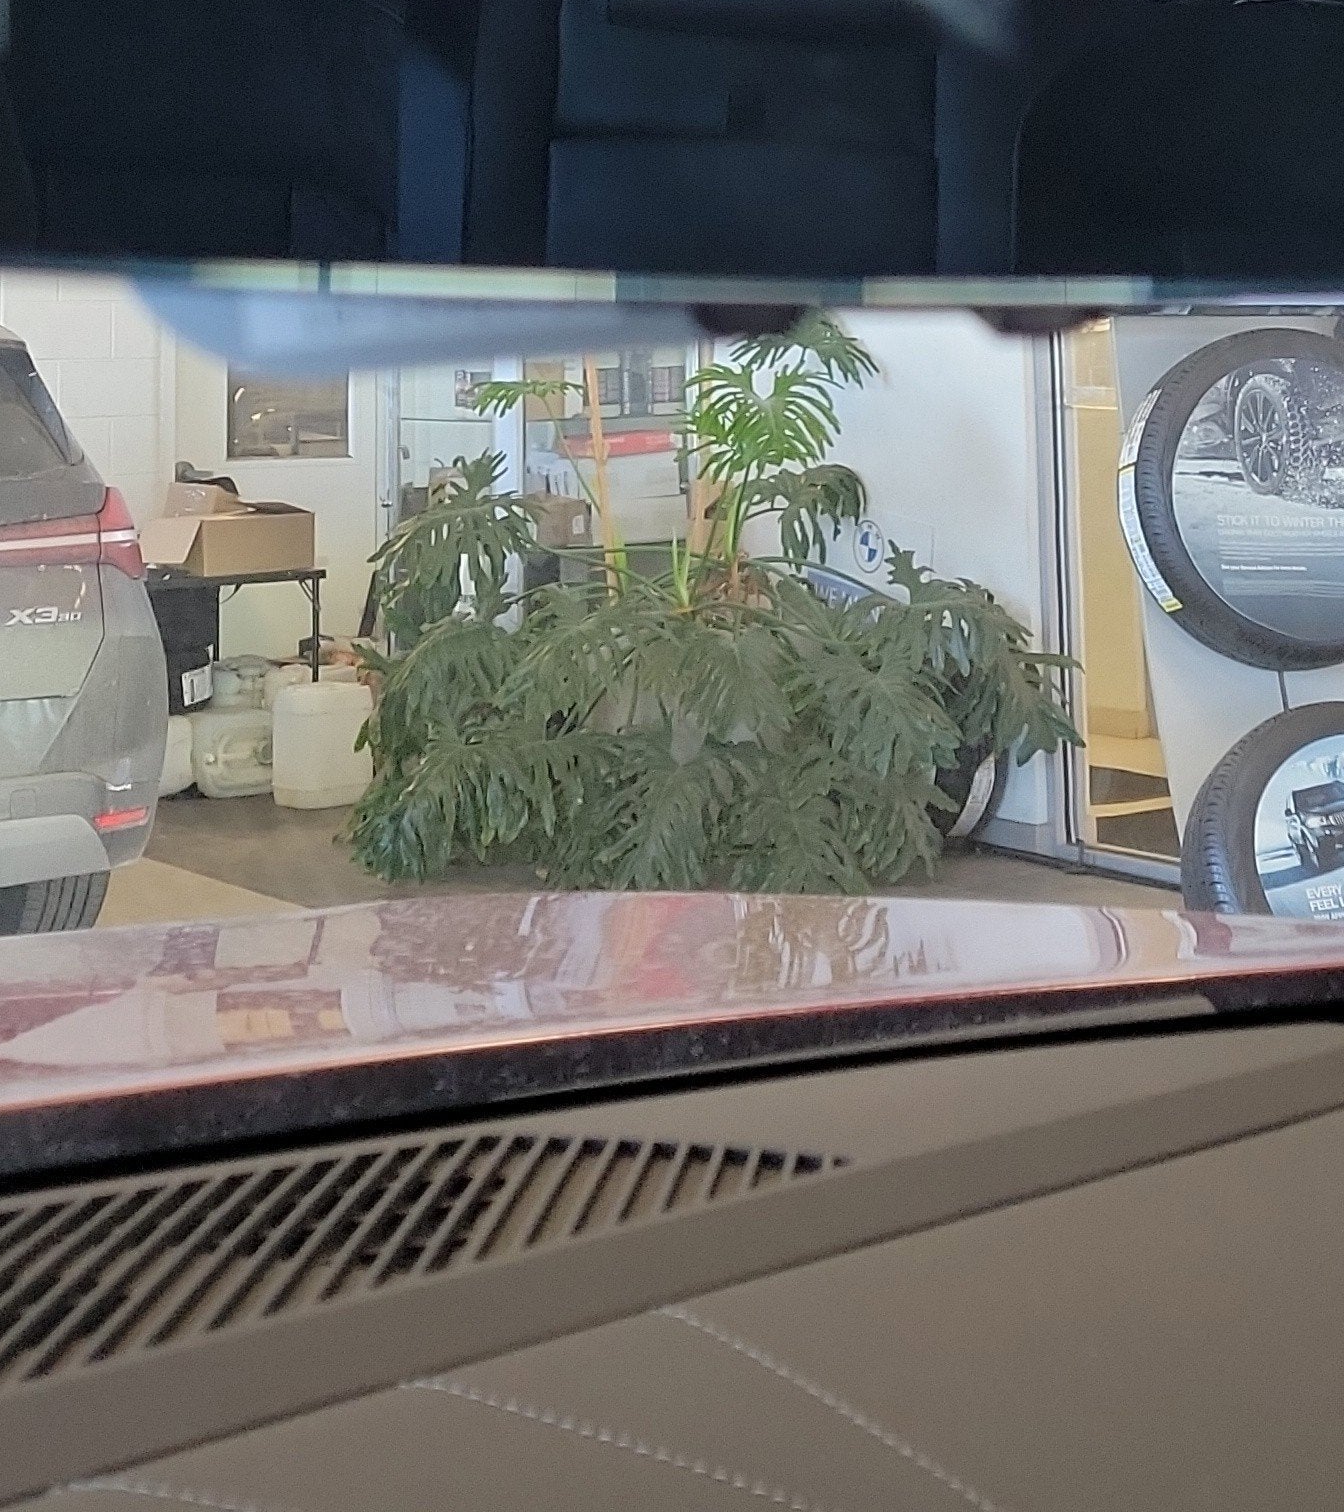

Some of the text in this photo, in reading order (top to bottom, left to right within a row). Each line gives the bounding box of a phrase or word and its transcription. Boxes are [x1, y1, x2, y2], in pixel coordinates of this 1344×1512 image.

[1217, 515, 1249, 527] STICK
[1264, 516, 1280, 527] TO
[1282, 516, 1325, 528] WINTER
[1, 606, 58, 626] X3
[1306, 884, 1344, 900] EVERY
[1309, 897, 1340, 912] FEEL
